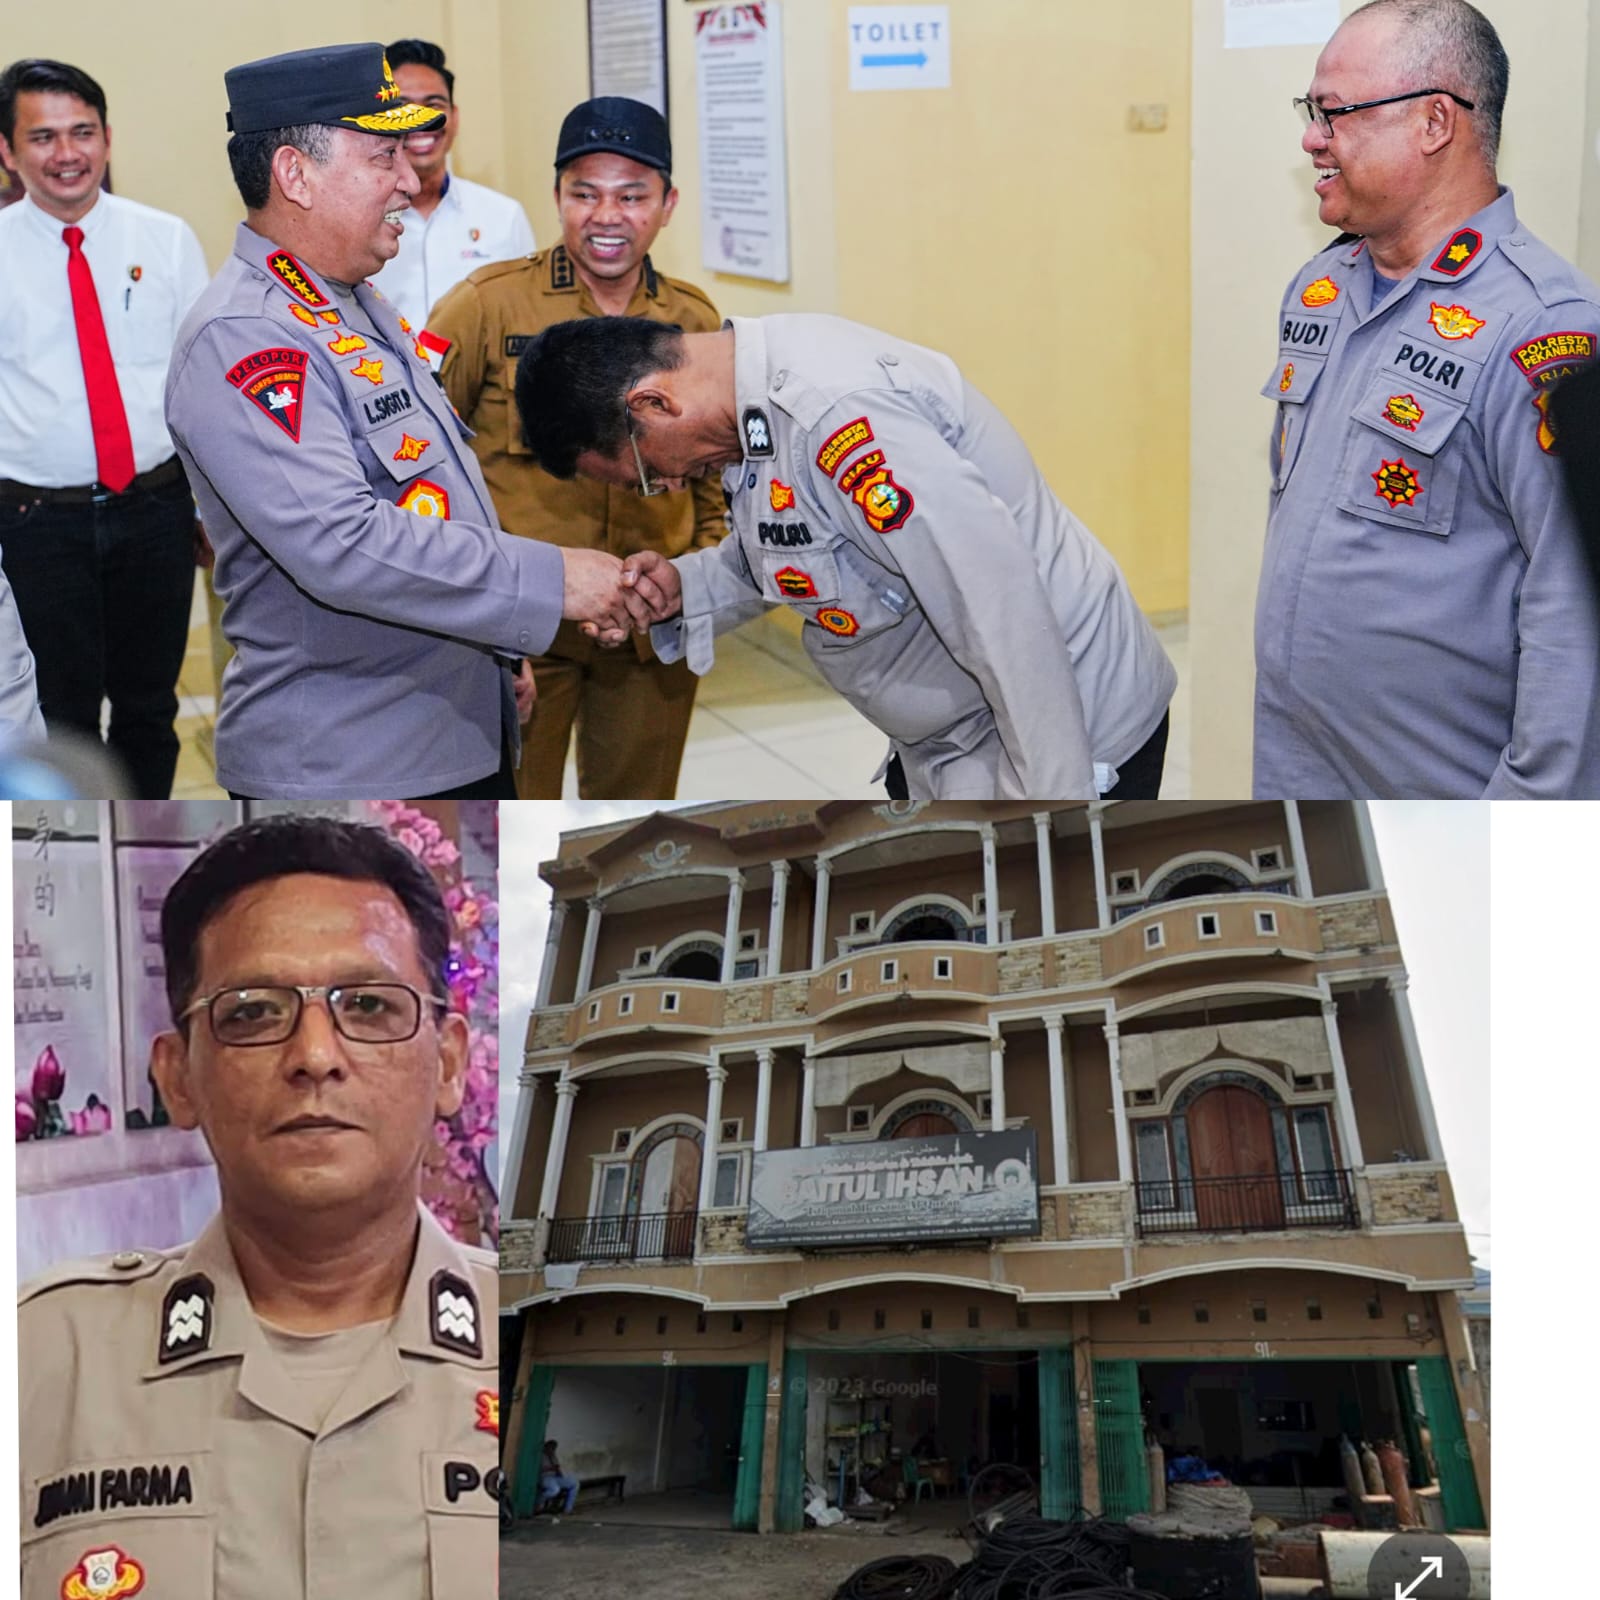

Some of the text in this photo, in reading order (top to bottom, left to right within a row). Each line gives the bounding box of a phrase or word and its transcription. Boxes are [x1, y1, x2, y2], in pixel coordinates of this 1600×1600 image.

[852, 22, 942, 42] TOILET
[1282, 319, 1327, 348] BUDI
[1518, 335, 1590, 361] POLRESTA
[232, 351, 301, 382] PELOPOR
[1394, 343, 1464, 391] POLRI
[1522, 343, 1591, 369] PEKANBARU
[1539, 365, 1581, 383] RIA
[842, 453, 880, 488] RIAU
[758, 521, 813, 547] POLRI
[886, 1165, 985, 1199] IHSAN
[100, 1464, 193, 1512] FARMA
